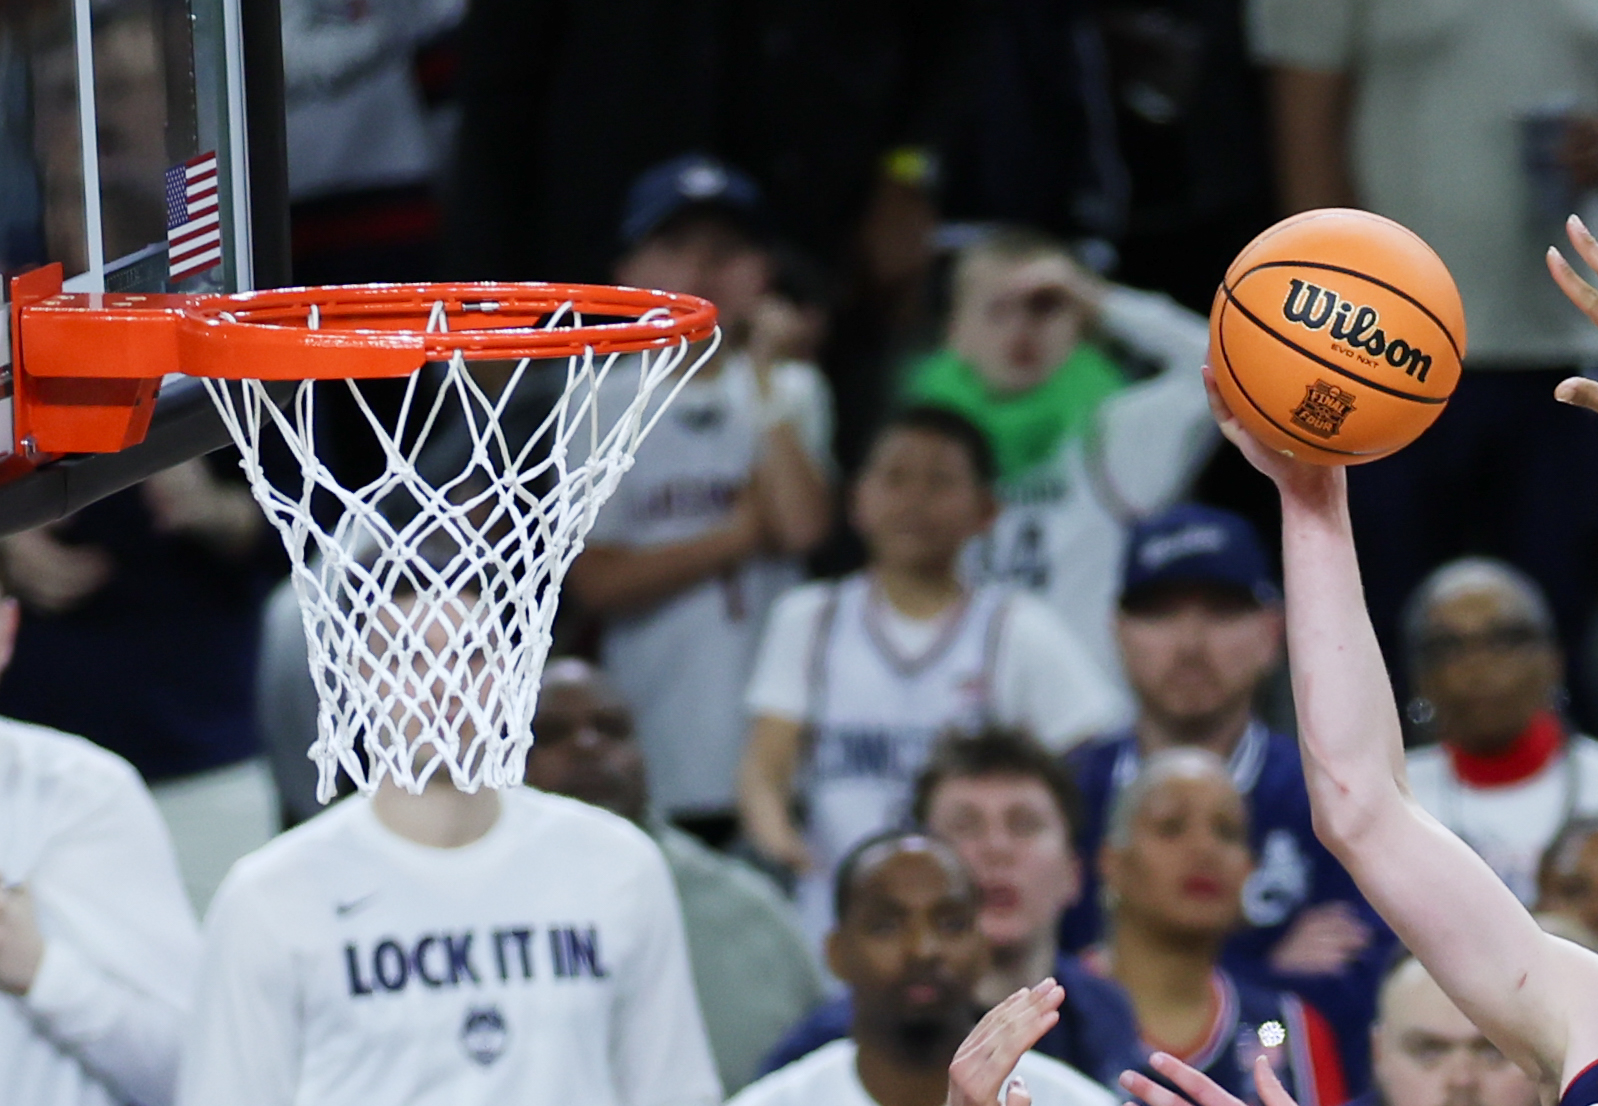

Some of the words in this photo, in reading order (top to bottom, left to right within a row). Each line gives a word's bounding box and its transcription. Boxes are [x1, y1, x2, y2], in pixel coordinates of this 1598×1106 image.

[1283, 278, 1432, 383] Wilson
[1331, 343, 1355, 358] EVO
[1355, 354, 1380, 369] NXT
[1311, 390, 1346, 414] FINAL
[1299, 410, 1333, 432] FOUR
[344, 931, 482, 997] LOCK
[493, 924, 533, 981] IT
